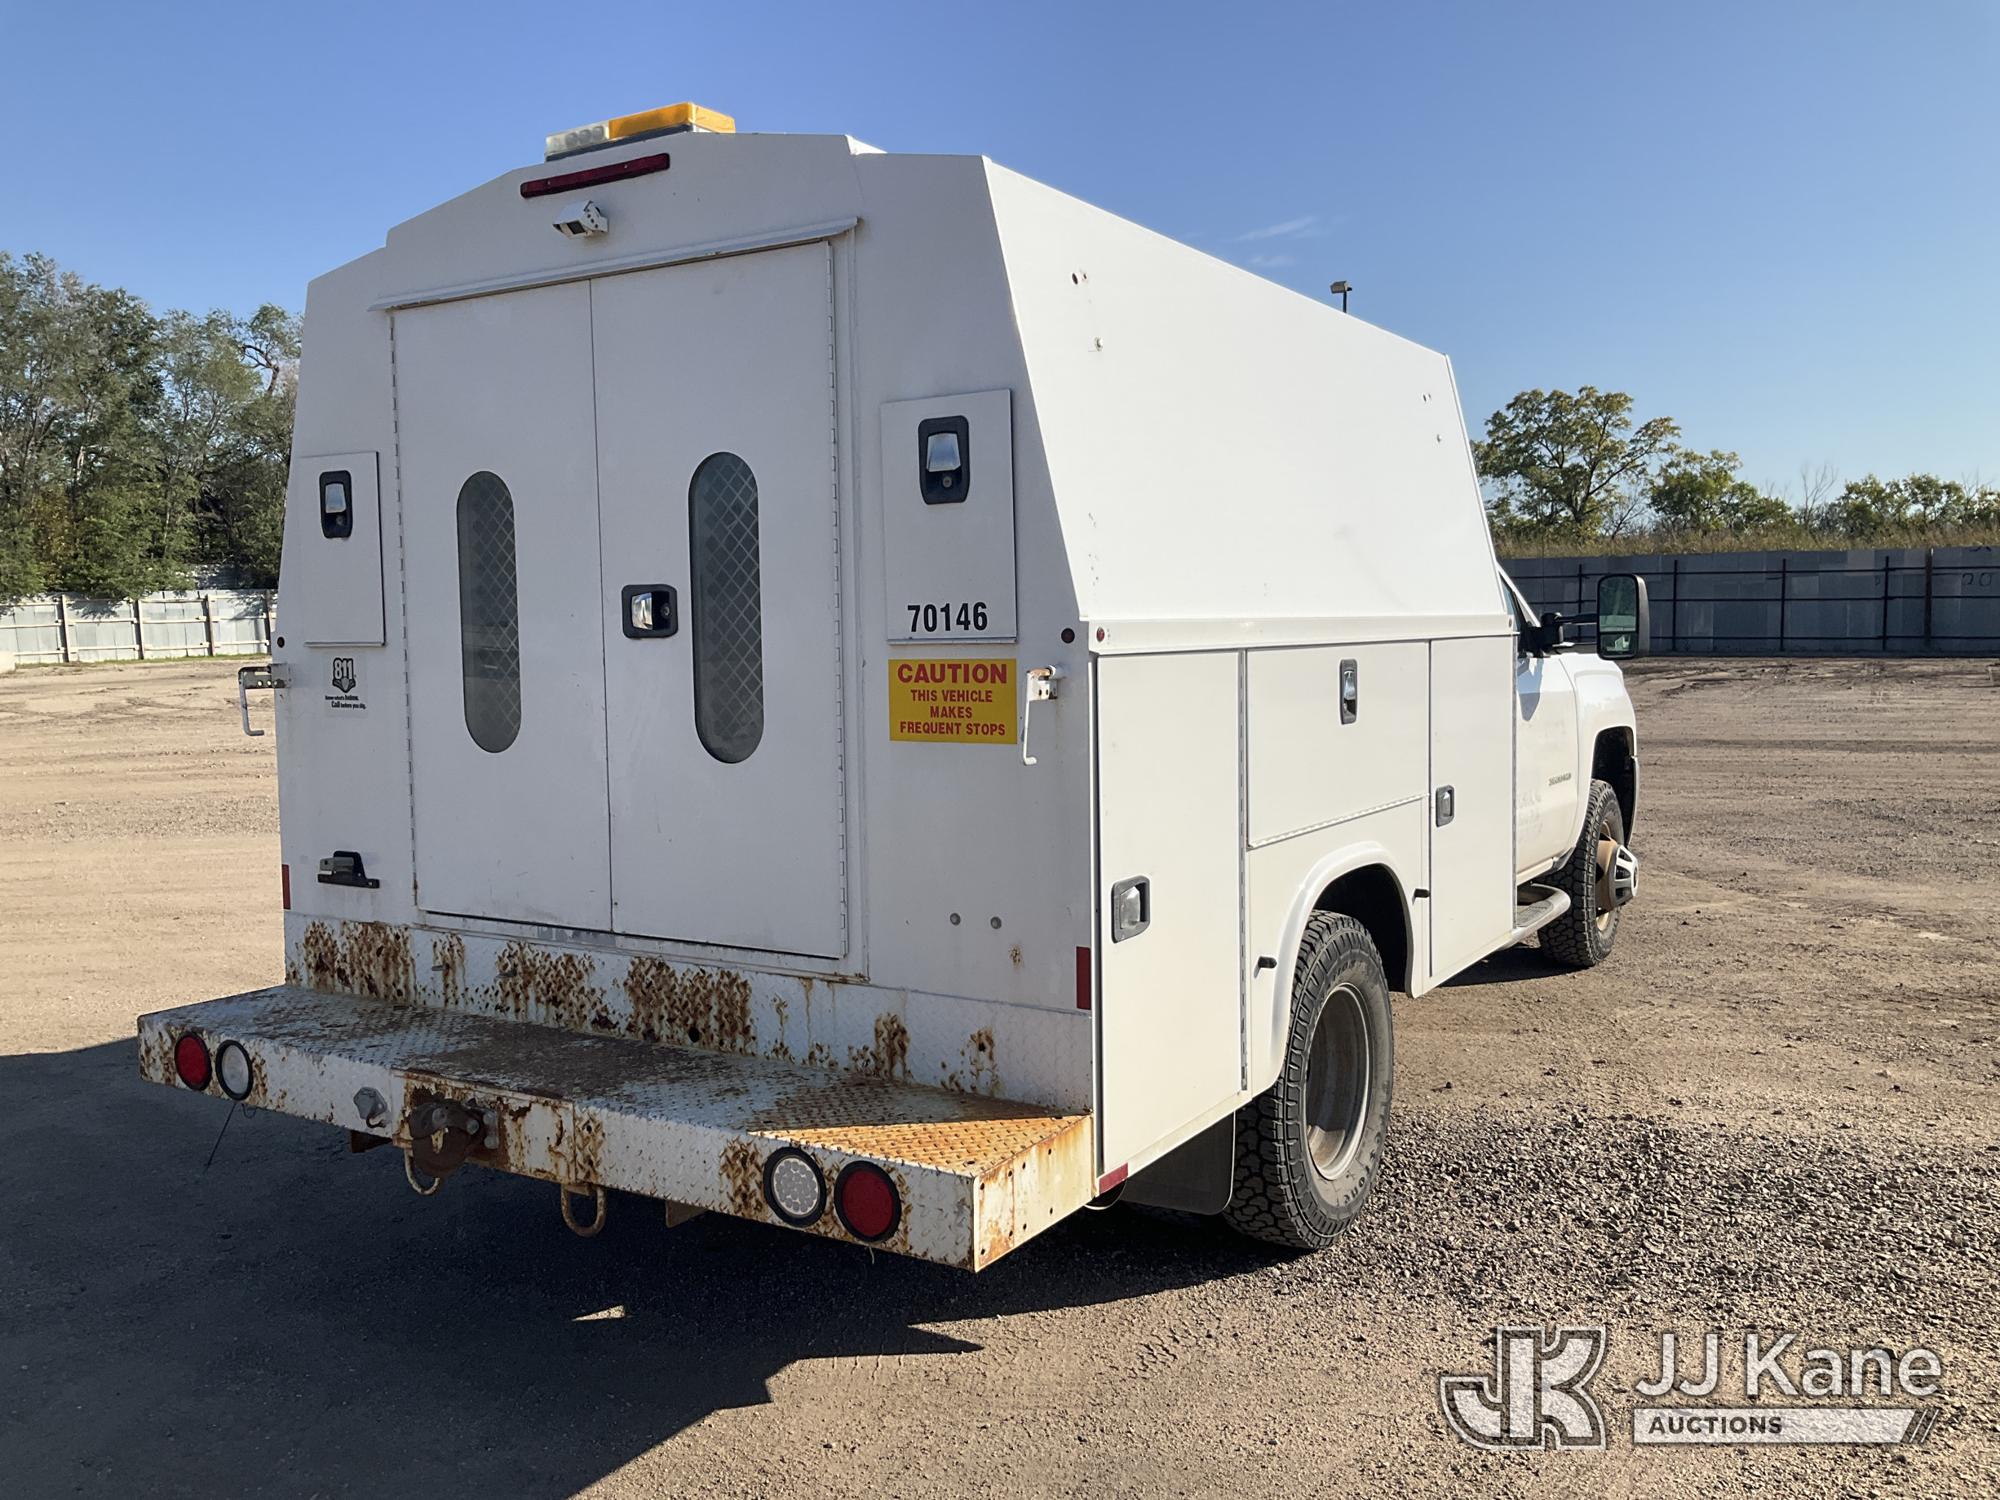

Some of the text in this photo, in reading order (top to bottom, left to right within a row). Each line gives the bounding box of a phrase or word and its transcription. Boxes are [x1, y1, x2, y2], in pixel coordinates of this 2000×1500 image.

[907, 602, 988, 632] 70146
[333, 657, 354, 680] 811
[897, 663, 1008, 684] CAUTION
[910, 689, 993, 703] THIS VEHICLE
[930, 706, 973, 719] MAKES
[900, 721, 1005, 736] FREQUENT STOPS
